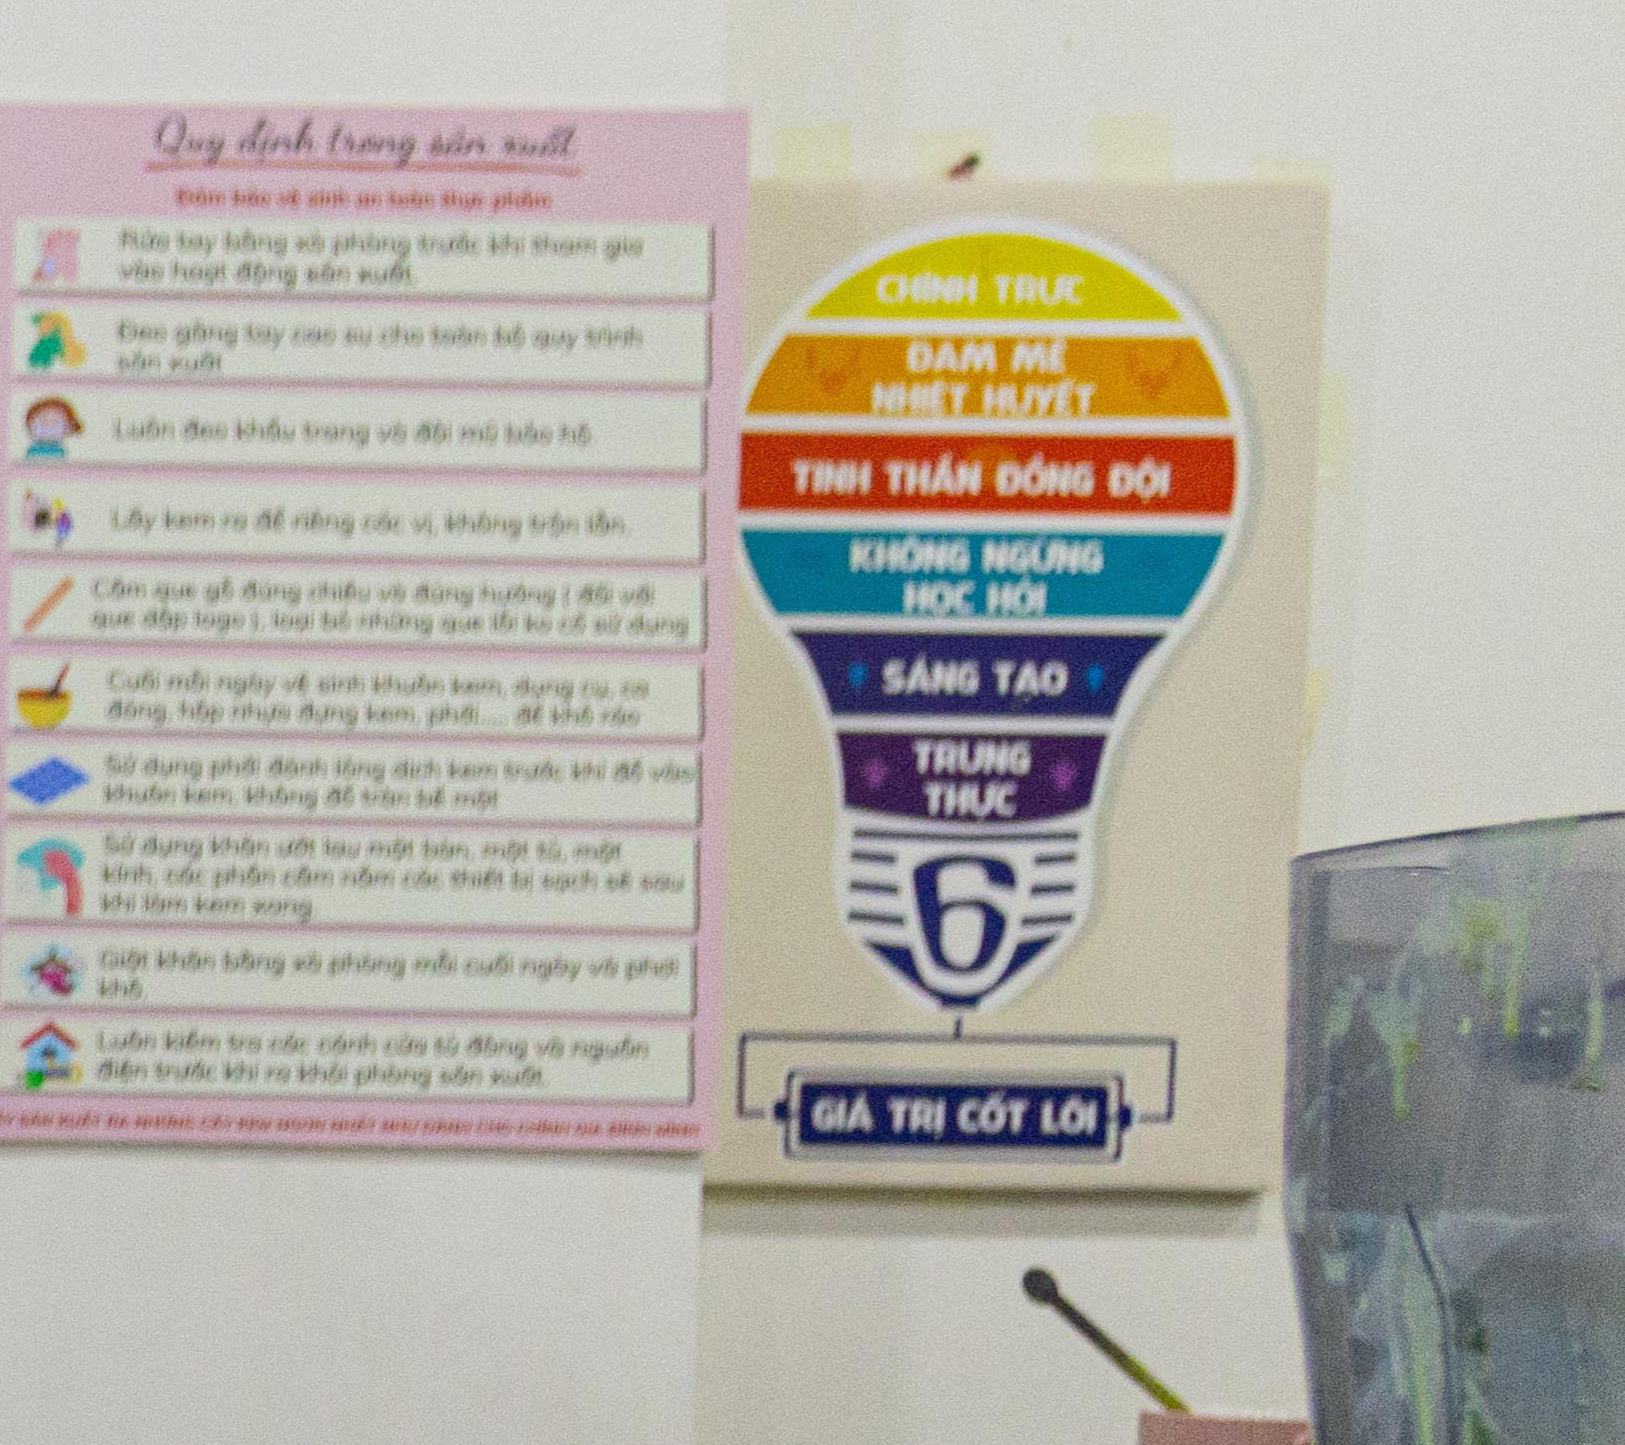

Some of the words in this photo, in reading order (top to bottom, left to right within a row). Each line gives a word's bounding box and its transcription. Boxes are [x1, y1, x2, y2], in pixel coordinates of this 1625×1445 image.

[327, 123, 416, 168] trong
[792, 458, 872, 497] TINH
[1107, 455, 1170, 504] ĐỘI
[849, 534, 970, 573] KHÔNG
[881, 652, 980, 697] SÁNG
[993, 661, 1068, 704] TẠO
[914, 738, 1031, 776] TRUNG
[913, 854, 1016, 974] 6
[811, 1091, 872, 1132] GIÁ
[888, 1097, 946, 1140] TRỊ
[957, 1090, 1028, 1135] CỐT
